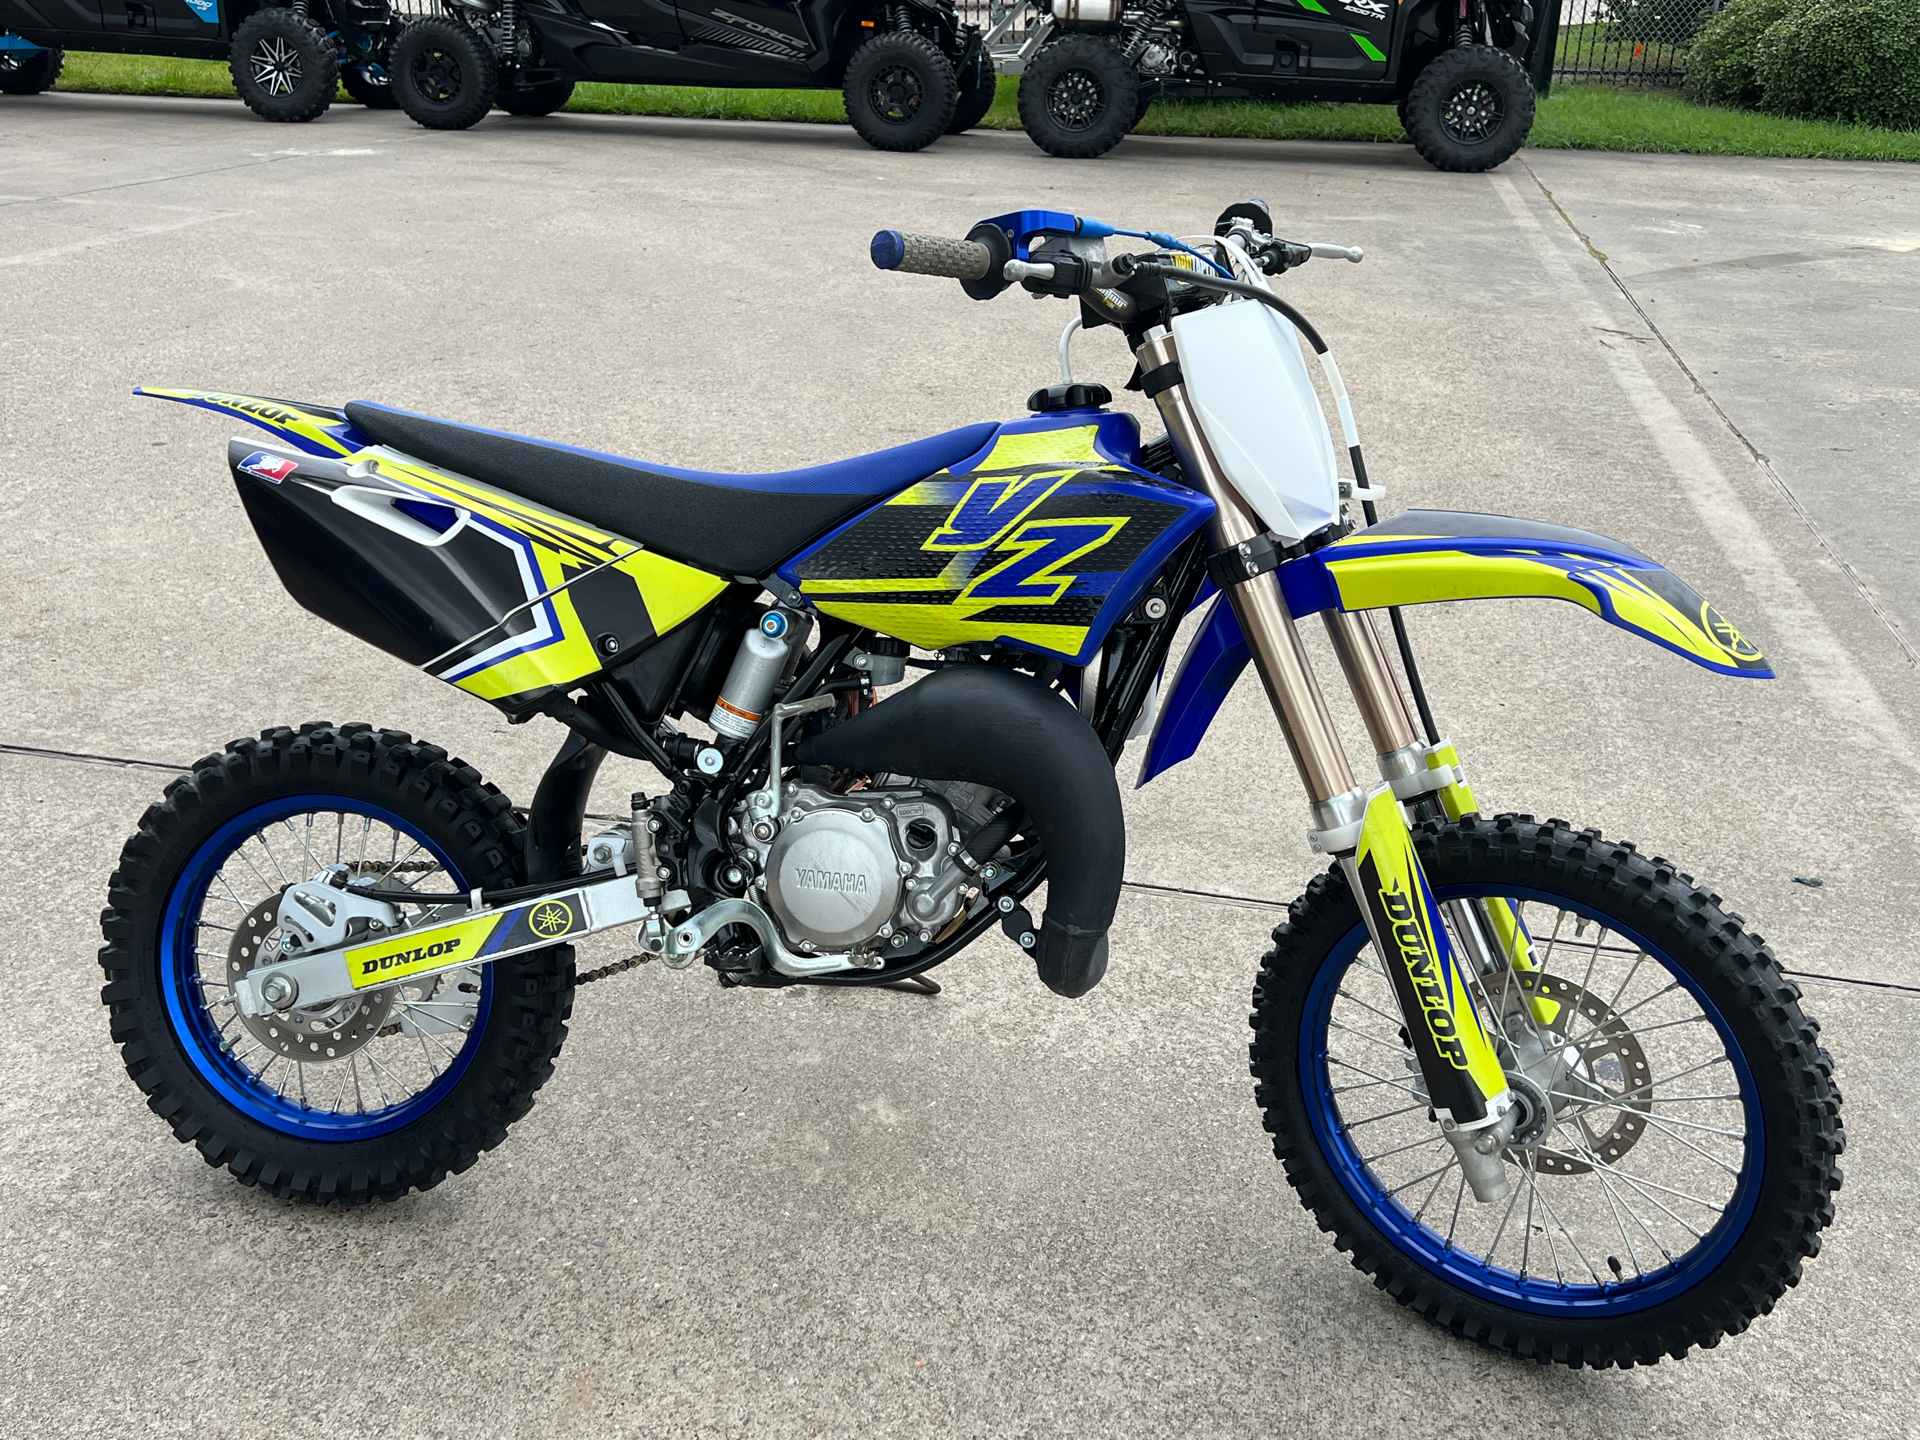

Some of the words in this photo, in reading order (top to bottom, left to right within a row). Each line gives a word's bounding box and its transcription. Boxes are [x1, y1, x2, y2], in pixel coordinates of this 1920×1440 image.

[795, 868, 867, 893] YAMAHA
[362, 938, 461, 975] DUNLOP
[1380, 890, 1469, 1068] DUNLOP
